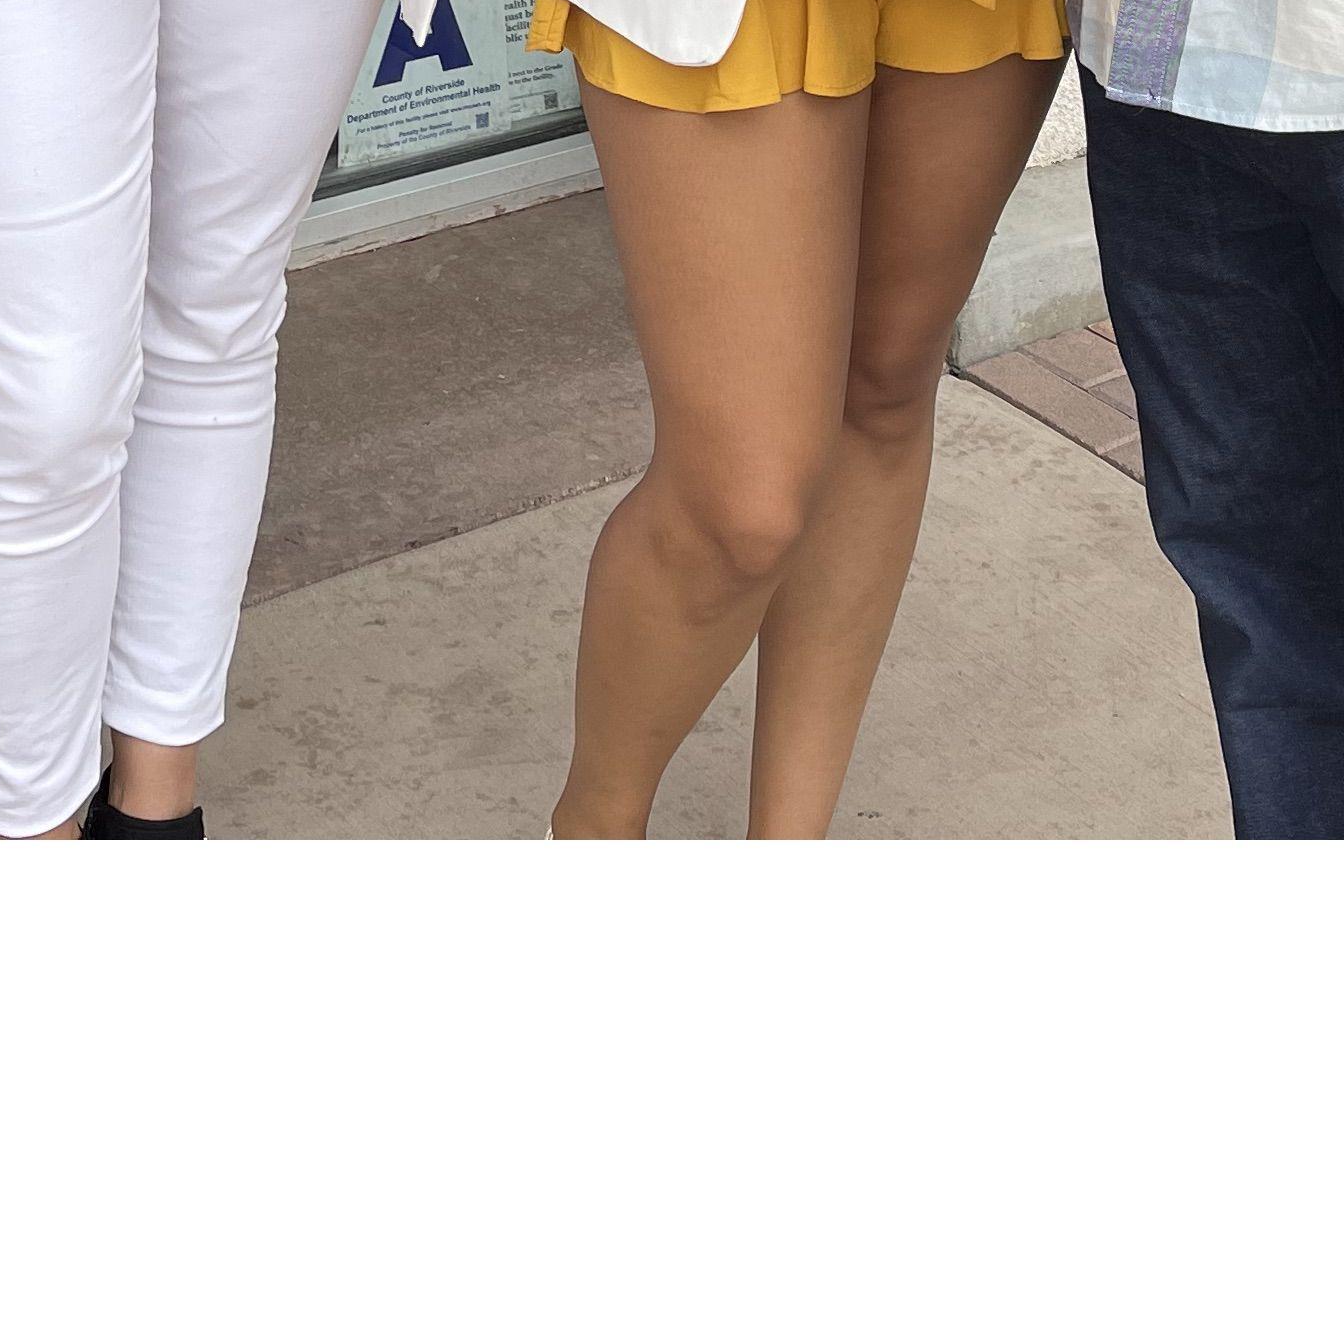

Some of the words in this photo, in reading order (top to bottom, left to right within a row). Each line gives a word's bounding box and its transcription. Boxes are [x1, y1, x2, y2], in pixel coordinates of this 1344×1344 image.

[346, 105, 397, 124] Department
[399, 103, 408, 113] of
[409, 88, 471, 110] Environmental
[472, 83, 501, 96] Health
[381, 90, 413, 105] County
[414, 87, 424, 97] of
[425, 78, 465, 94] Riverside
